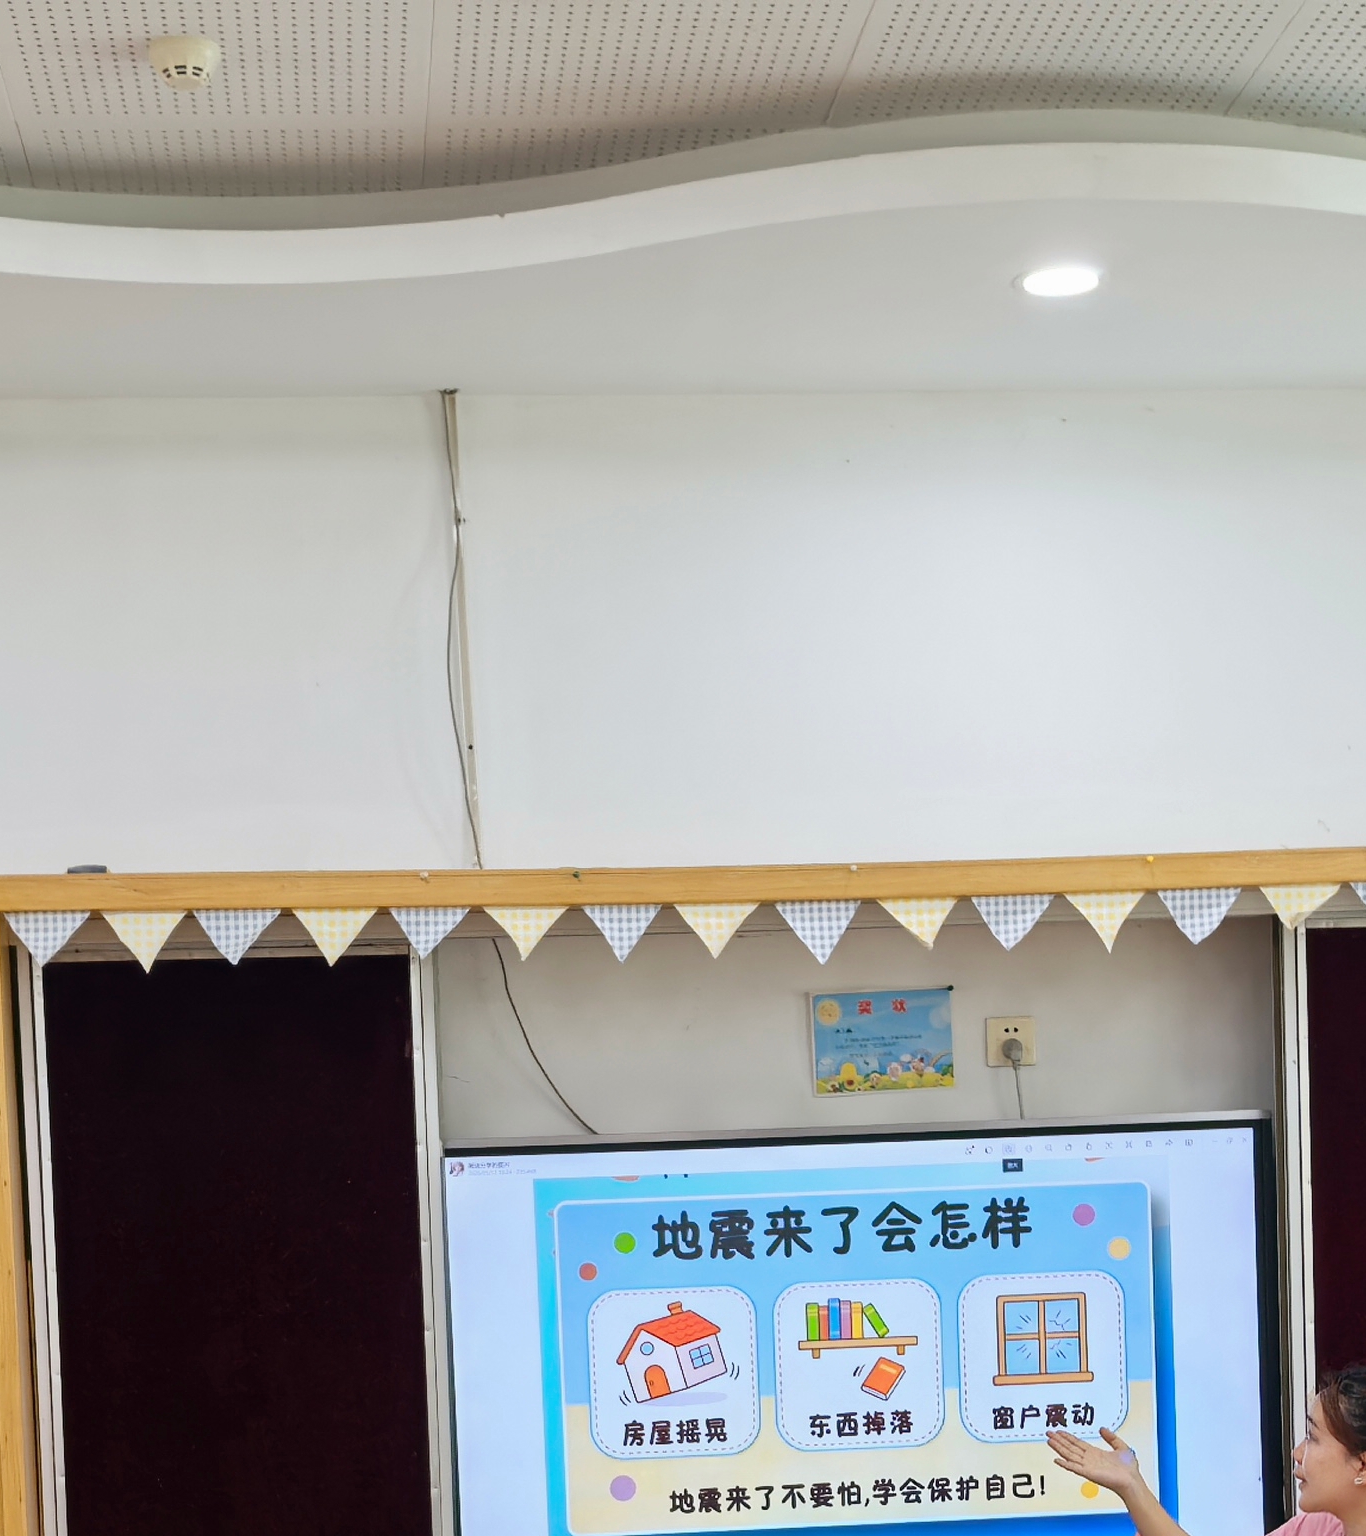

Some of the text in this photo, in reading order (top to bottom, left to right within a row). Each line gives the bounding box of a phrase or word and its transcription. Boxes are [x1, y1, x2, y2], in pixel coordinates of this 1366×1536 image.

[650, 1196, 1034, 1262] 地震来了会怎样
[808, 1408, 915, 1439] 东西掉落
[991, 1400, 1097, 1431] 窗户震动
[622, 1417, 729, 1448] 房屋摇晃
